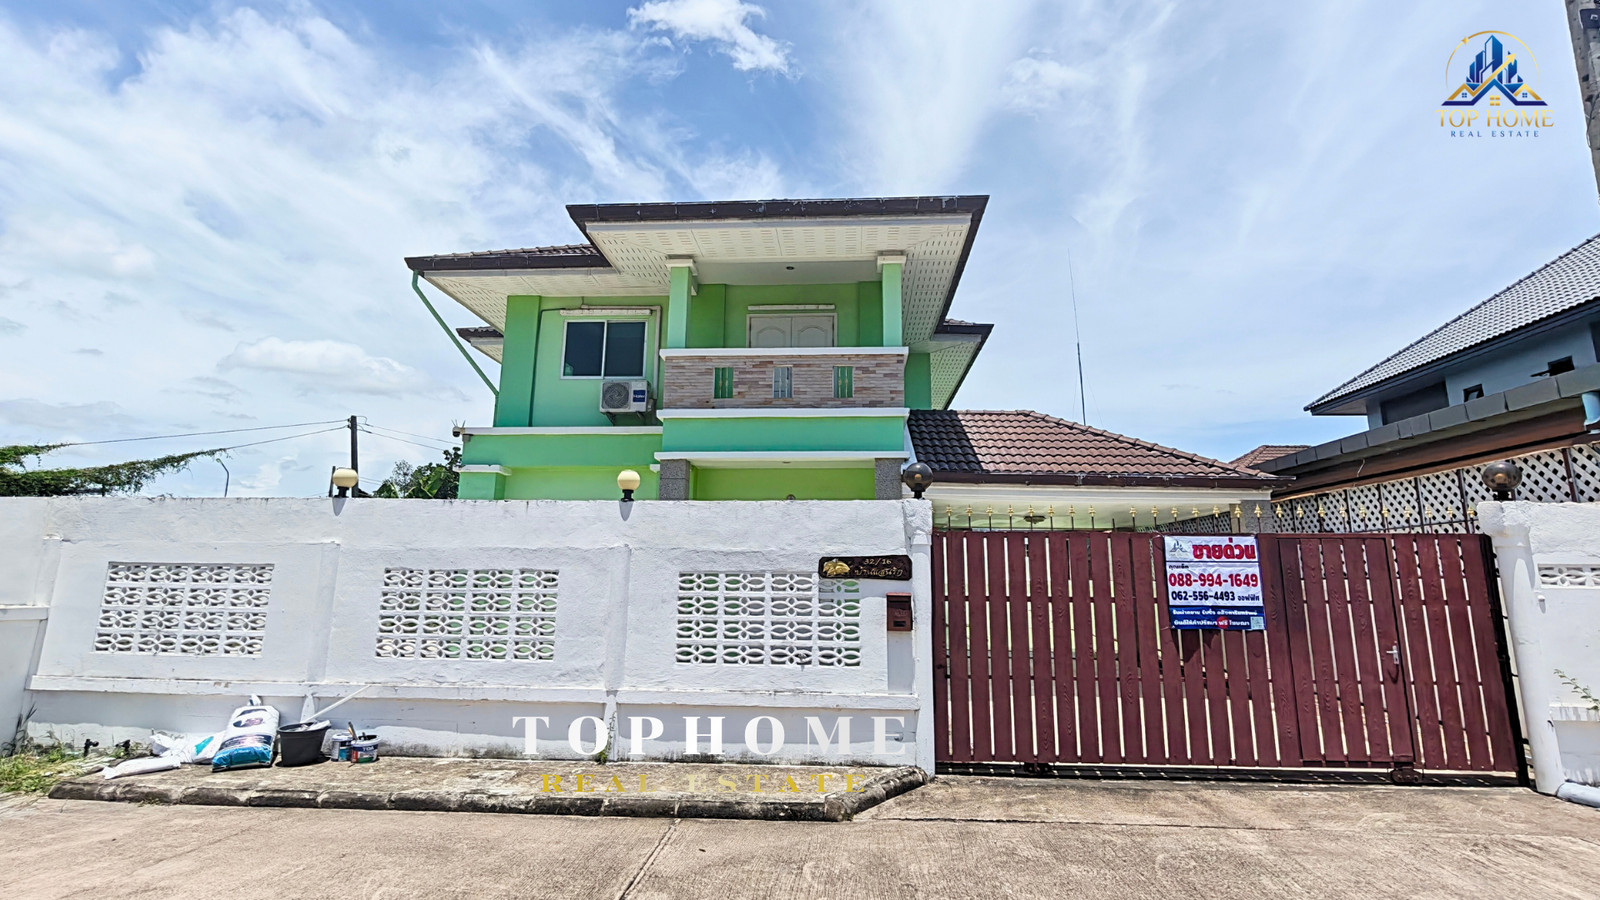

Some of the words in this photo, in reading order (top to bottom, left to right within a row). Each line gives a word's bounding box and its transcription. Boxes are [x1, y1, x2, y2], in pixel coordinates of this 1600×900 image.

[1192, 537, 1256, 560] ขายด่วน
[1169, 573, 1258, 587] 088-994-1649
[1171, 590, 1235, 601] 062-556-4493
